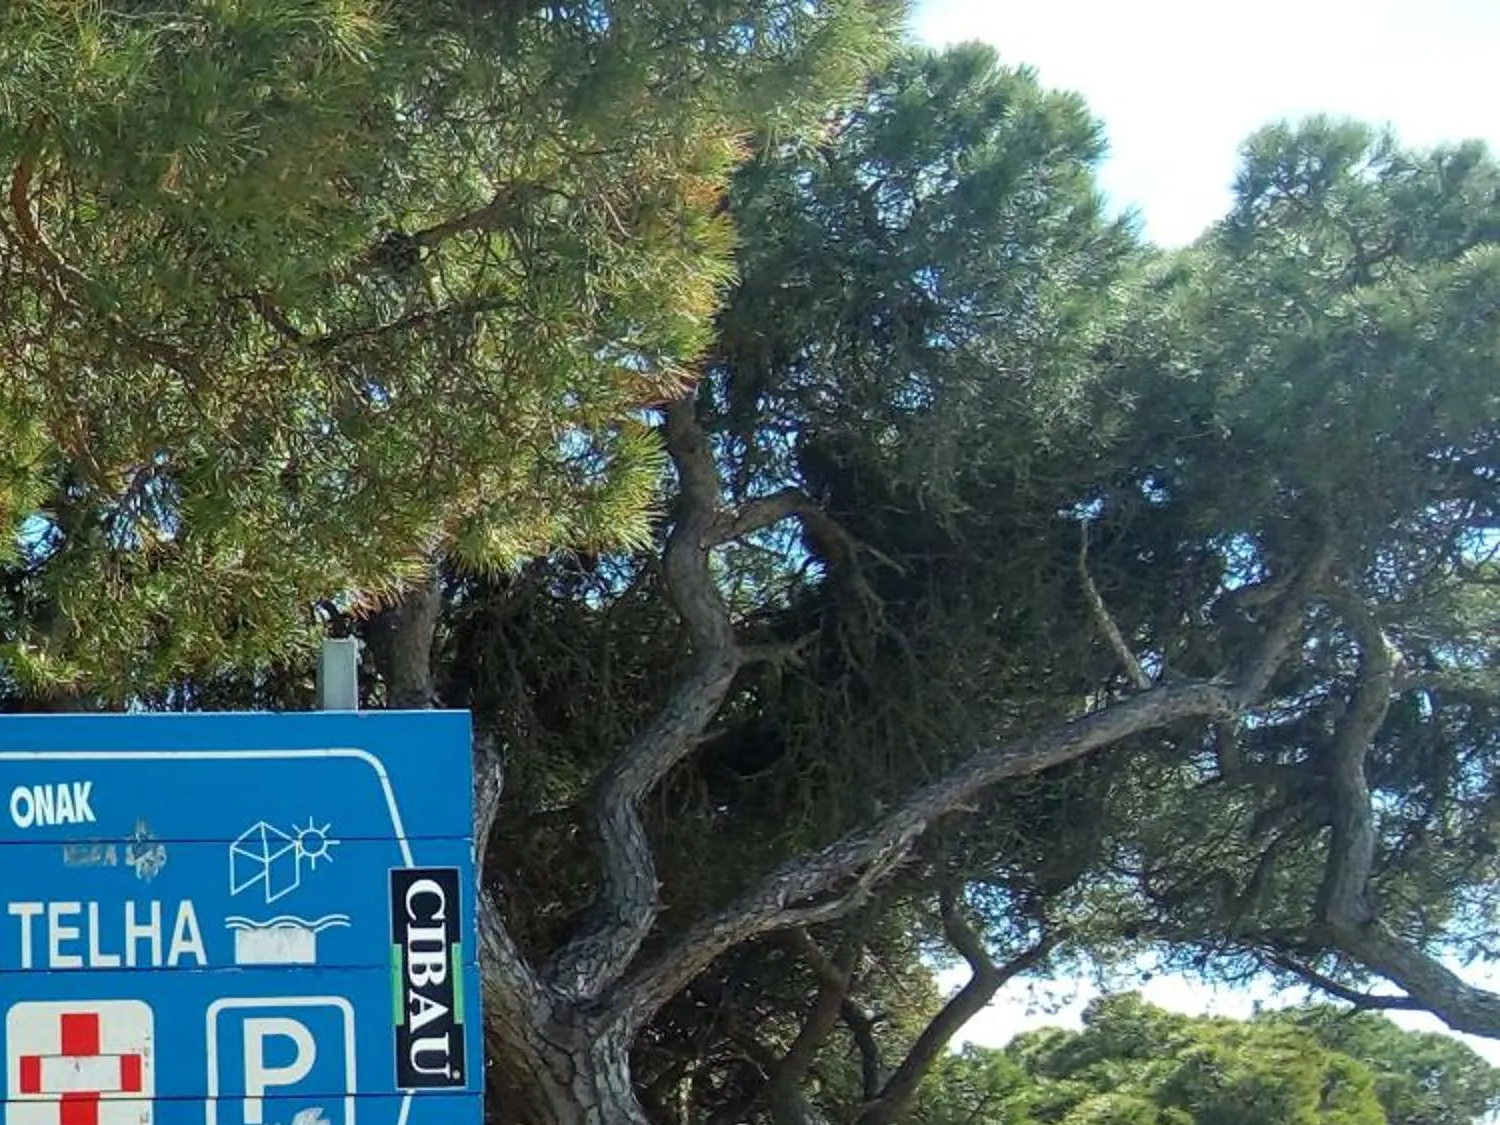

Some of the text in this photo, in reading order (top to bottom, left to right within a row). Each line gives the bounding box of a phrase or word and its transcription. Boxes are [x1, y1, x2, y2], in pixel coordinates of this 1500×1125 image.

[9, 781, 96, 829] ONAK
[7, 899, 208, 969] TELHA
[405, 879, 451, 1080] CIBAU
[243, 1017, 317, 1125] P
